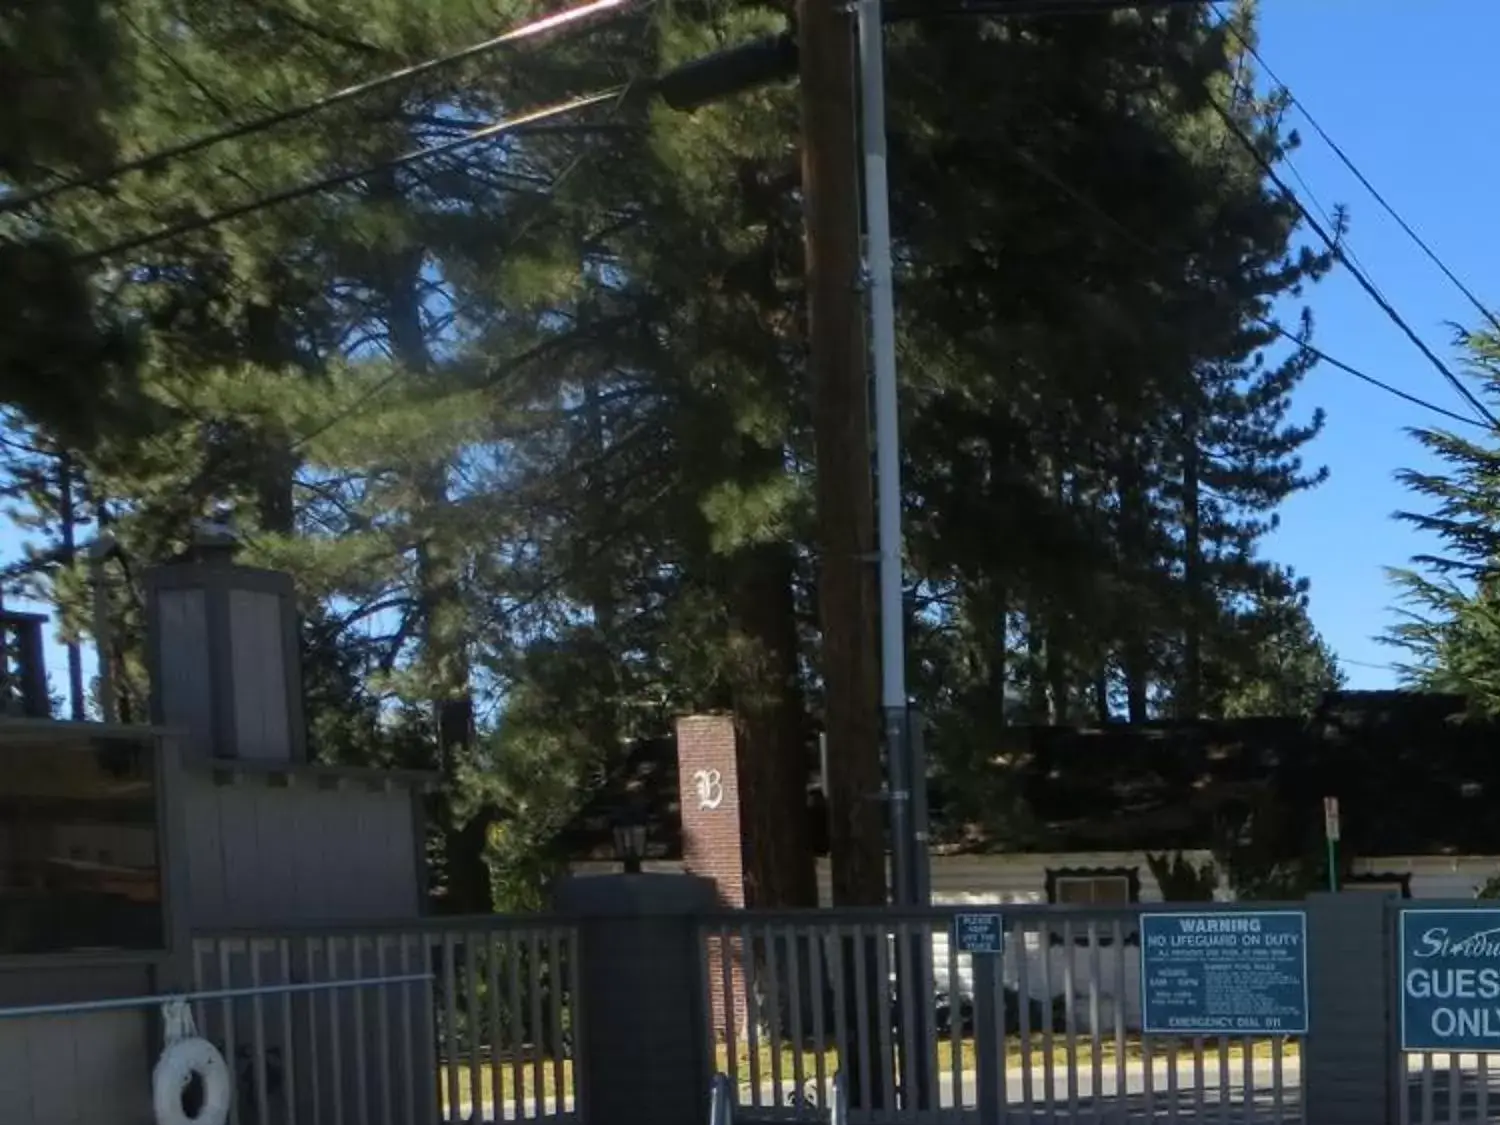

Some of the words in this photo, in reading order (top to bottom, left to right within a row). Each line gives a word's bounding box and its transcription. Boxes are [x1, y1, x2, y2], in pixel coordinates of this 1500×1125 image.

[1179, 918, 1261, 933] WARNING
[1147, 934, 1167, 947] NO
[1171, 934, 1237, 947] LIFEGUARD
[1241, 934, 1261, 946] ON
[1265, 933, 1299, 946] DUTY
[1168, 1016, 1233, 1027] EMERGENCY
[1237, 1016, 1260, 1027] DIAL
